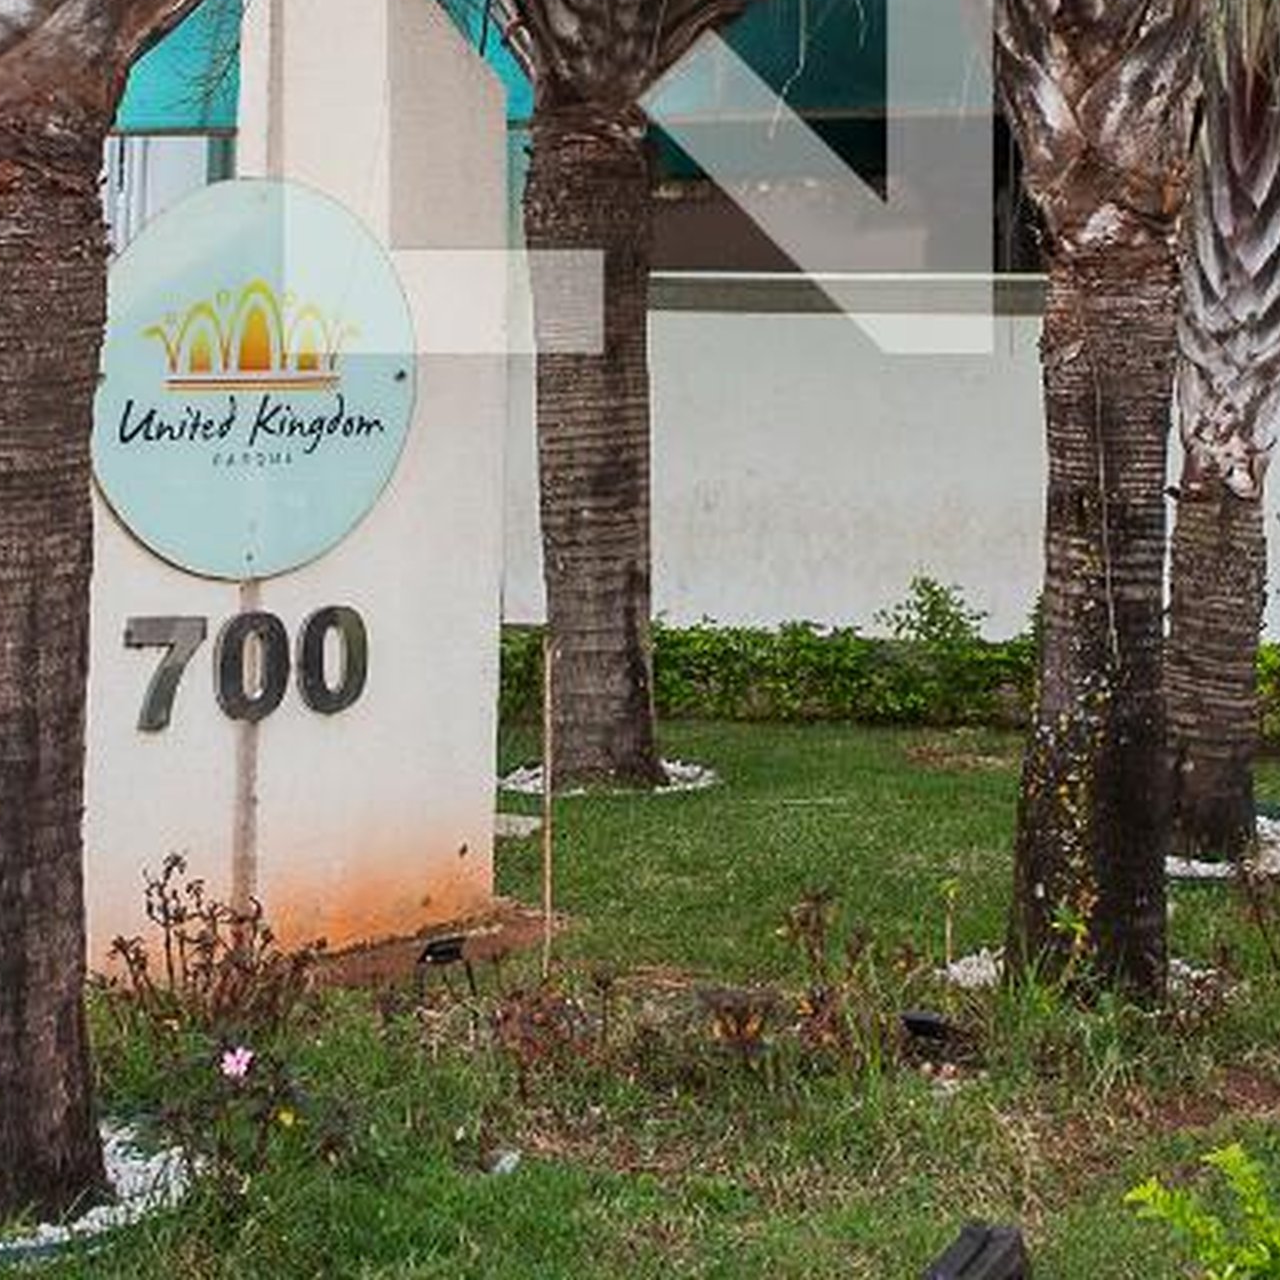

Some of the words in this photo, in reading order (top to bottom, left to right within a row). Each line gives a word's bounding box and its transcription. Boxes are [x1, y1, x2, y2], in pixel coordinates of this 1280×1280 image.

[119, 395, 237, 443] United
[249, 393, 385, 454] Kingdom
[124, 606, 369, 731] 700
